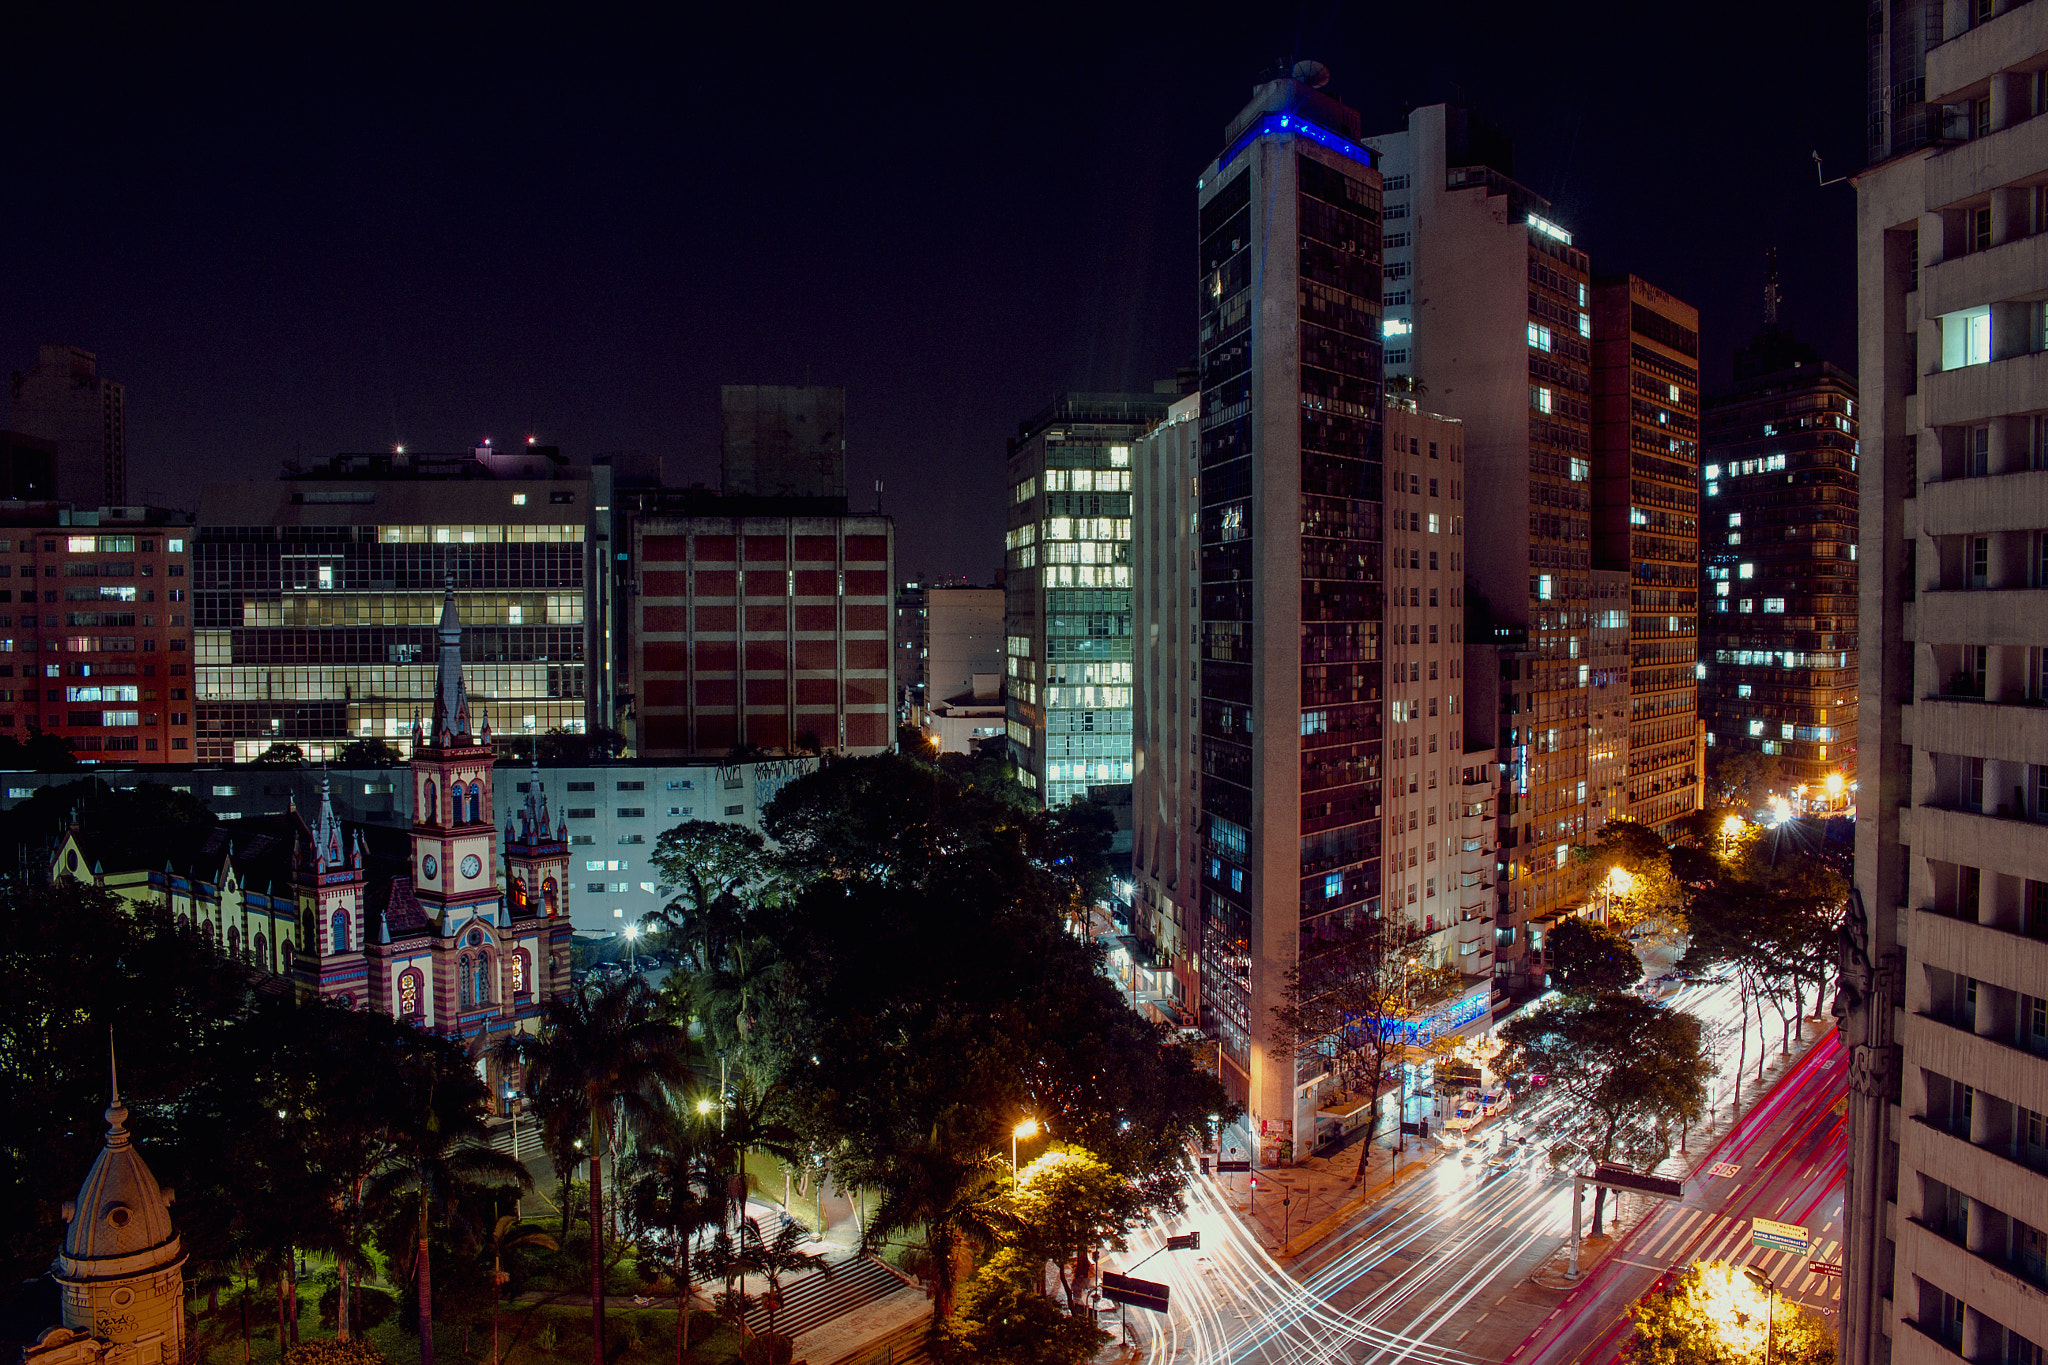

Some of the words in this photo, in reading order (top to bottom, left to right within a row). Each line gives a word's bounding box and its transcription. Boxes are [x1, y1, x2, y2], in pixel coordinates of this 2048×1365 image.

[1711, 1163, 1738, 1176] SOS
[1769, 1235, 1801, 1246] Internacional
[1778, 1244, 1800, 1254] VITÓRIA
